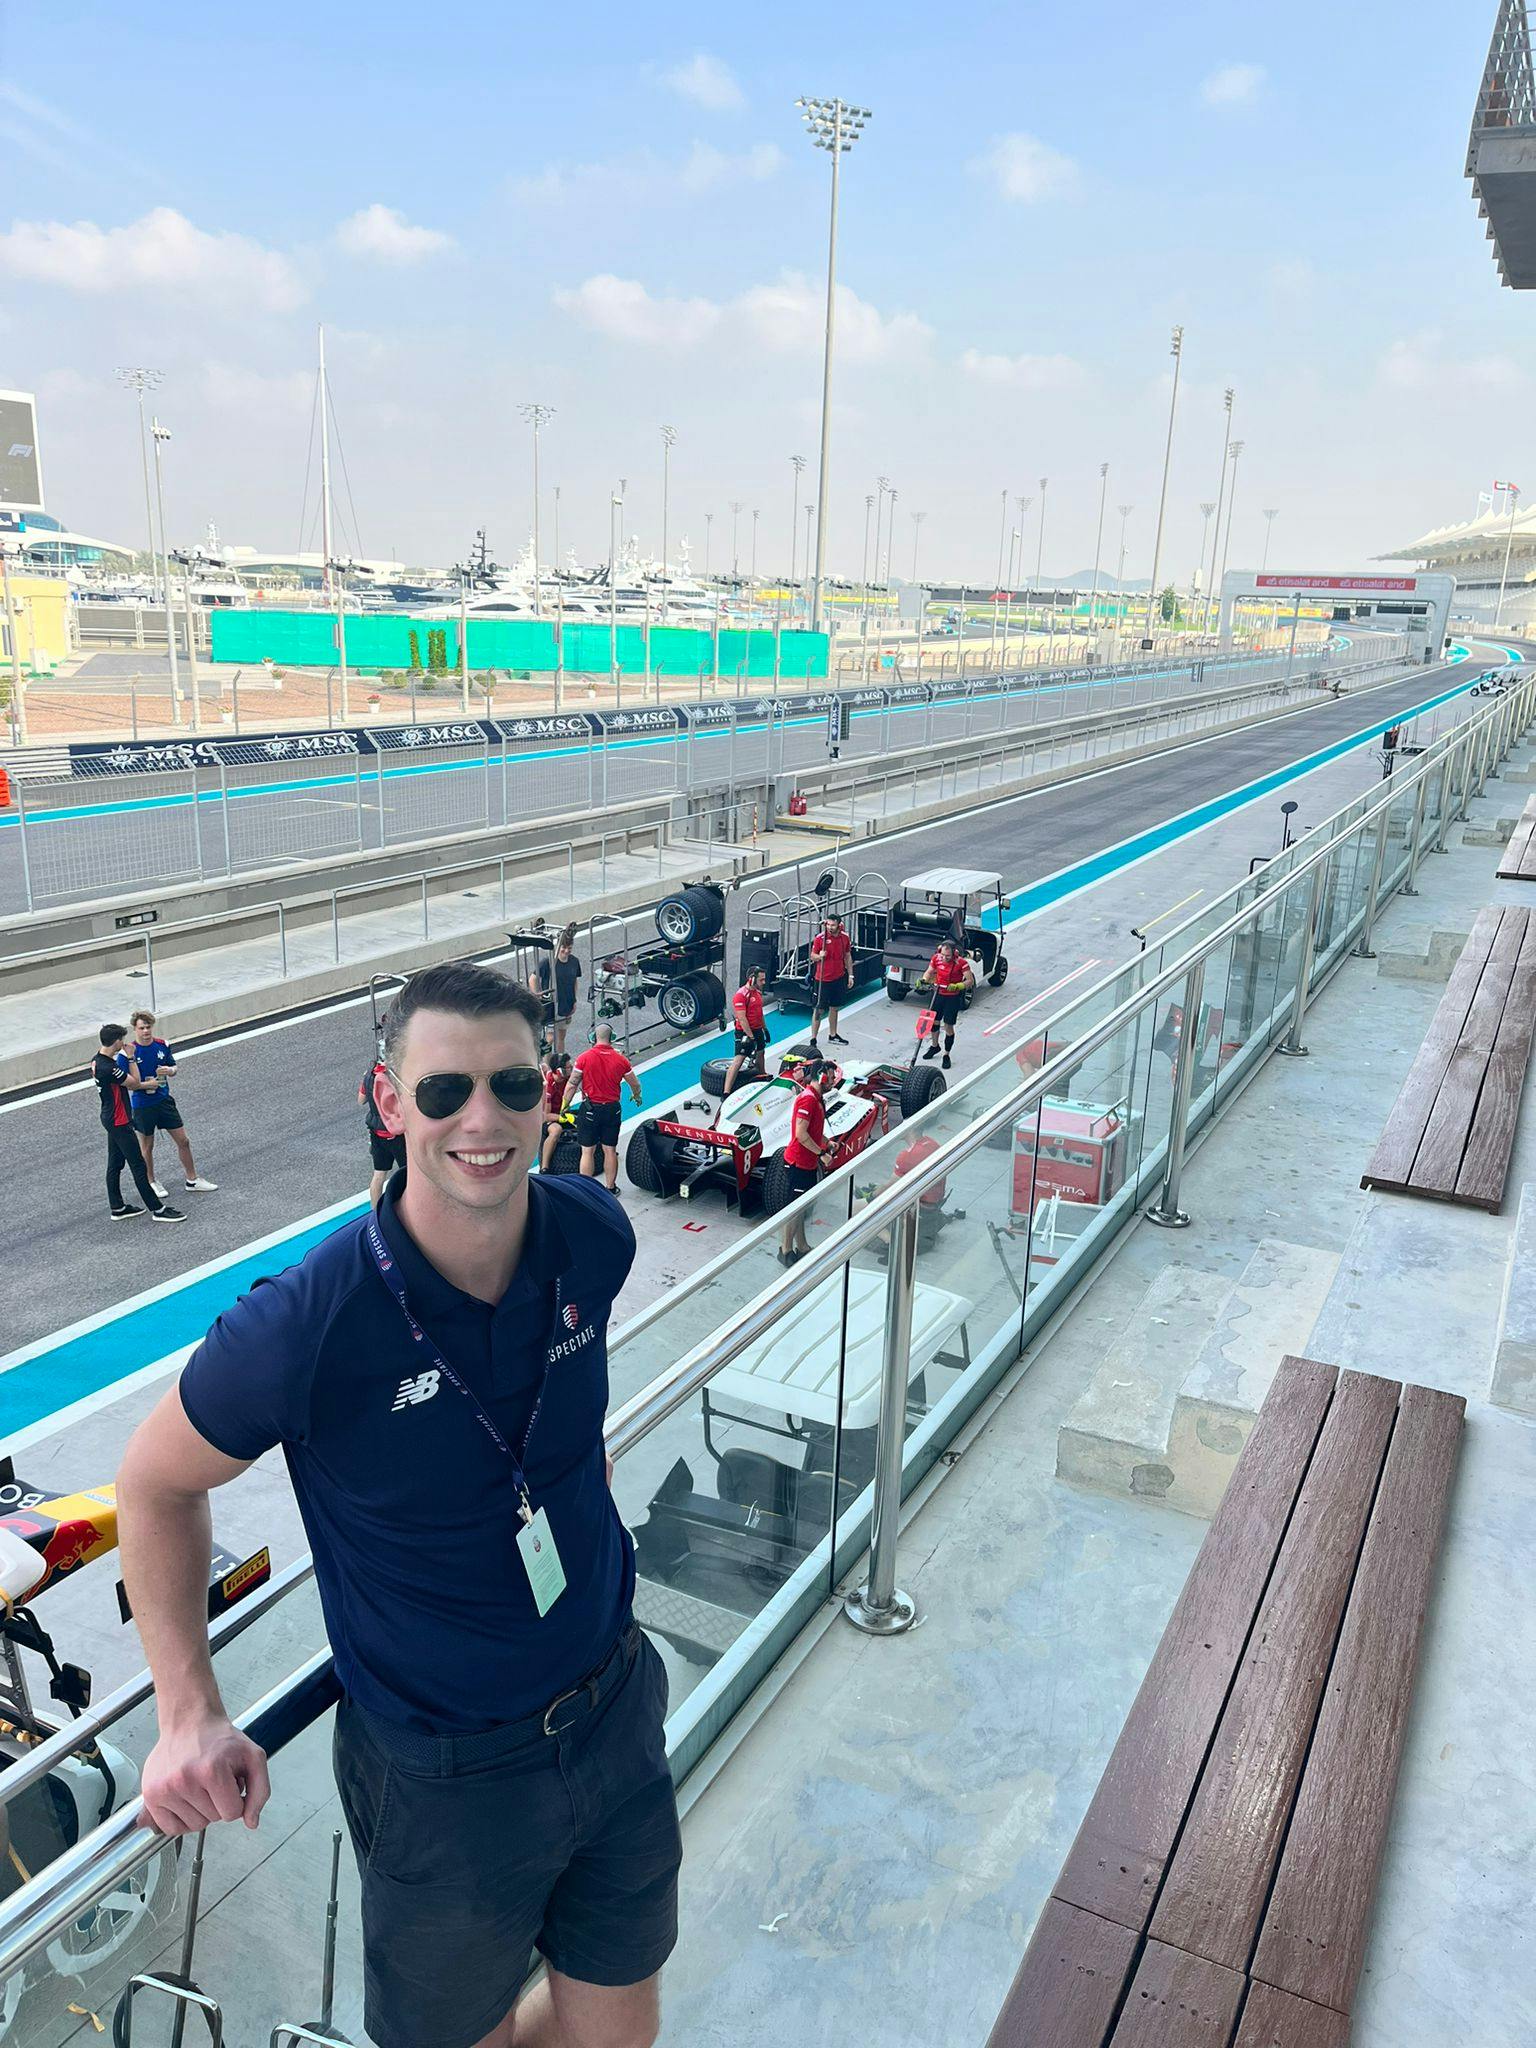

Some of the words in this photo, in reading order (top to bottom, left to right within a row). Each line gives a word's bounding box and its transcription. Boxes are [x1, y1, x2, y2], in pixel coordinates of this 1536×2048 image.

[1278, 577, 1310, 586] etisalat
[1352, 579, 1386, 588] etisalat
[536, 718, 583, 733] MSC
[632, 711, 671, 724] MSC
[429, 724, 481, 740] MSC
[297, 734, 358, 750] MSC
[144, 742, 217, 761] MSC
[664, 1124, 738, 1146] AVENTUM
[743, 1150, 751, 1175] 8
[547, 1325, 596, 1363] SPECTATE
[226, 1553, 266, 1592] PIRELLI
